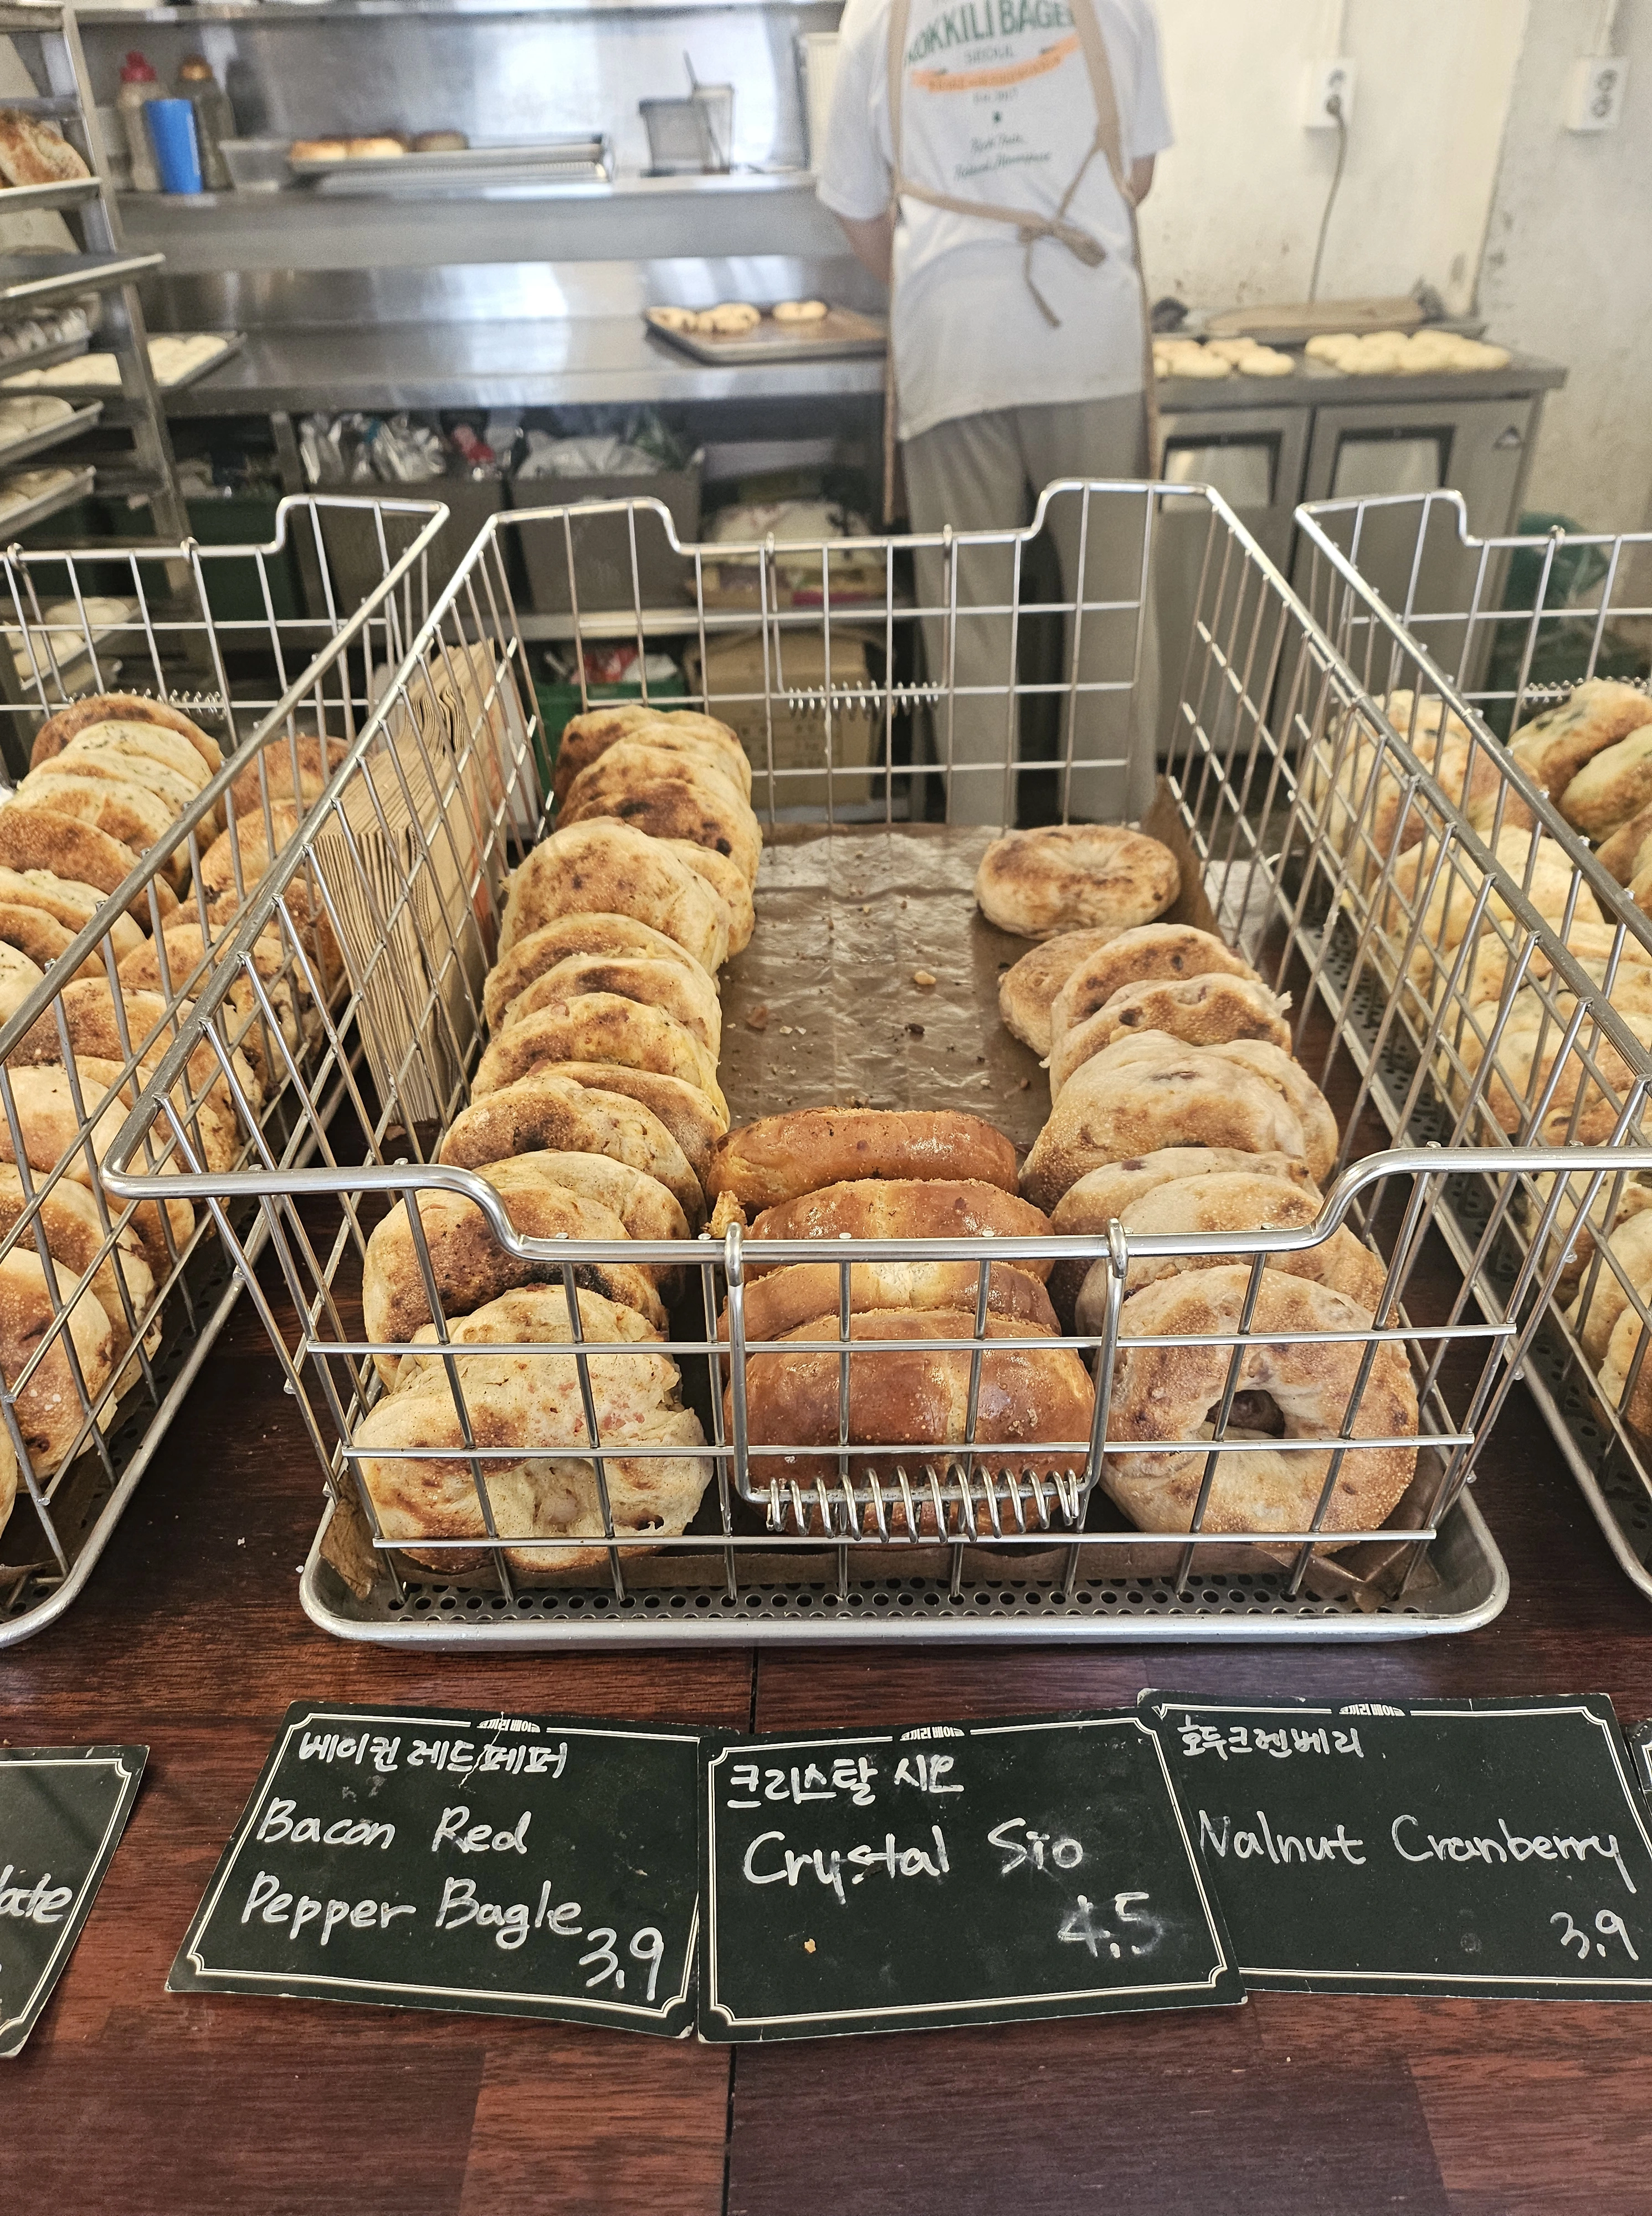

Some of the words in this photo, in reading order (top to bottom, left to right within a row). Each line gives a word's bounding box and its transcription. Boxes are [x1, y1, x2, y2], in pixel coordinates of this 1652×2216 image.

[727, 1757, 879, 1809] 크리스탈
[257, 1797, 396, 1850] Bacon
[431, 1805, 529, 1854] Red
[743, 1825, 950, 1905] Crystal
[987, 1817, 1084, 1874] Sio
[1391, 1814, 1638, 1894] Cranberry
[241, 1870, 417, 1946] Pepper
[435, 1876, 583, 1950] Bagle
